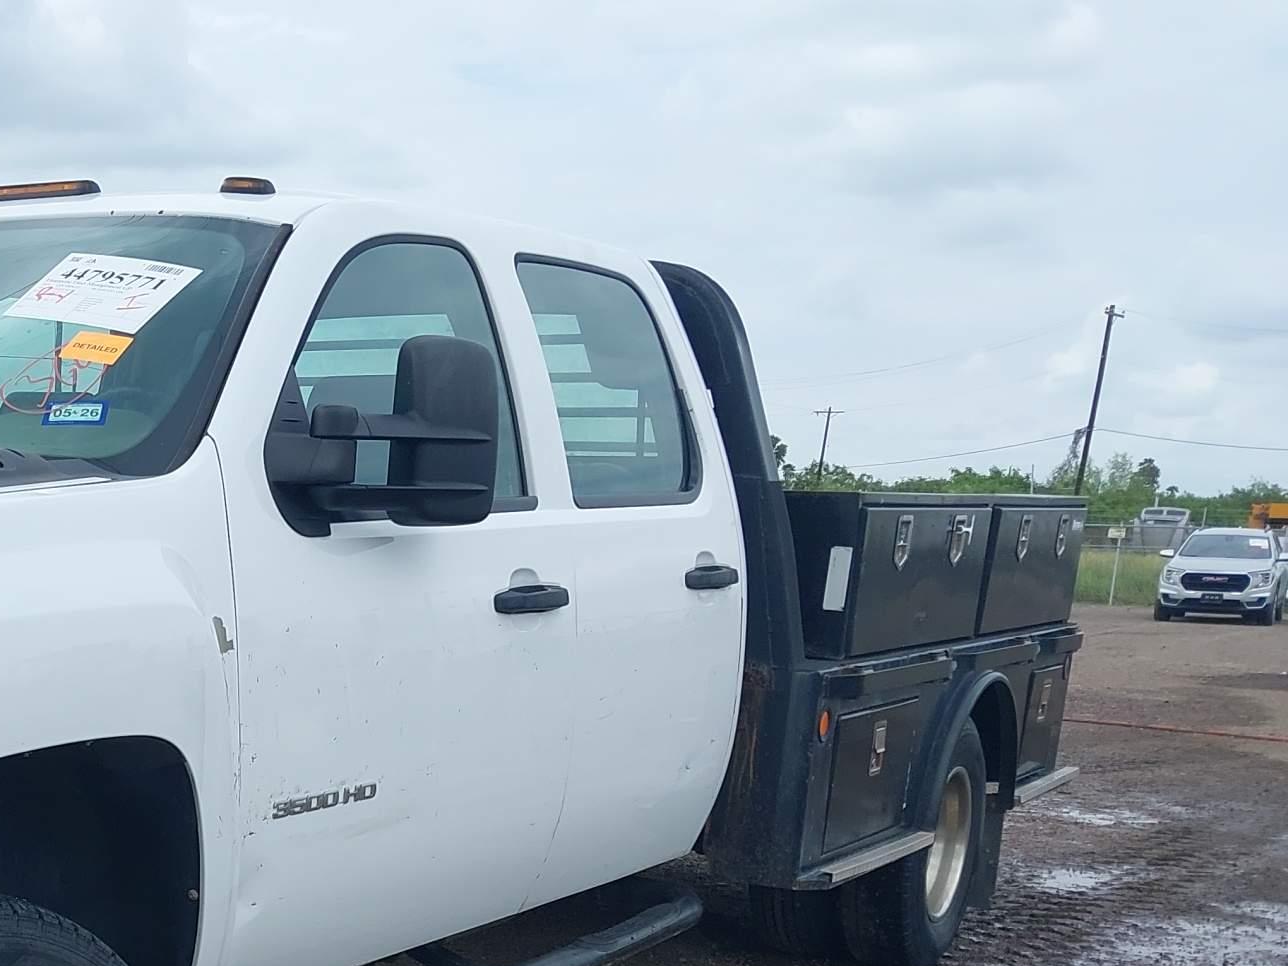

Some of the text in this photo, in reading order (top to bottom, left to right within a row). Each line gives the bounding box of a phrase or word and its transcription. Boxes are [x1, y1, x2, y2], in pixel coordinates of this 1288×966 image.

[61, 267, 167, 291] 44795771
[72, 342, 118, 354] DETAILED
[272, 783, 377, 819] 3500 HD
